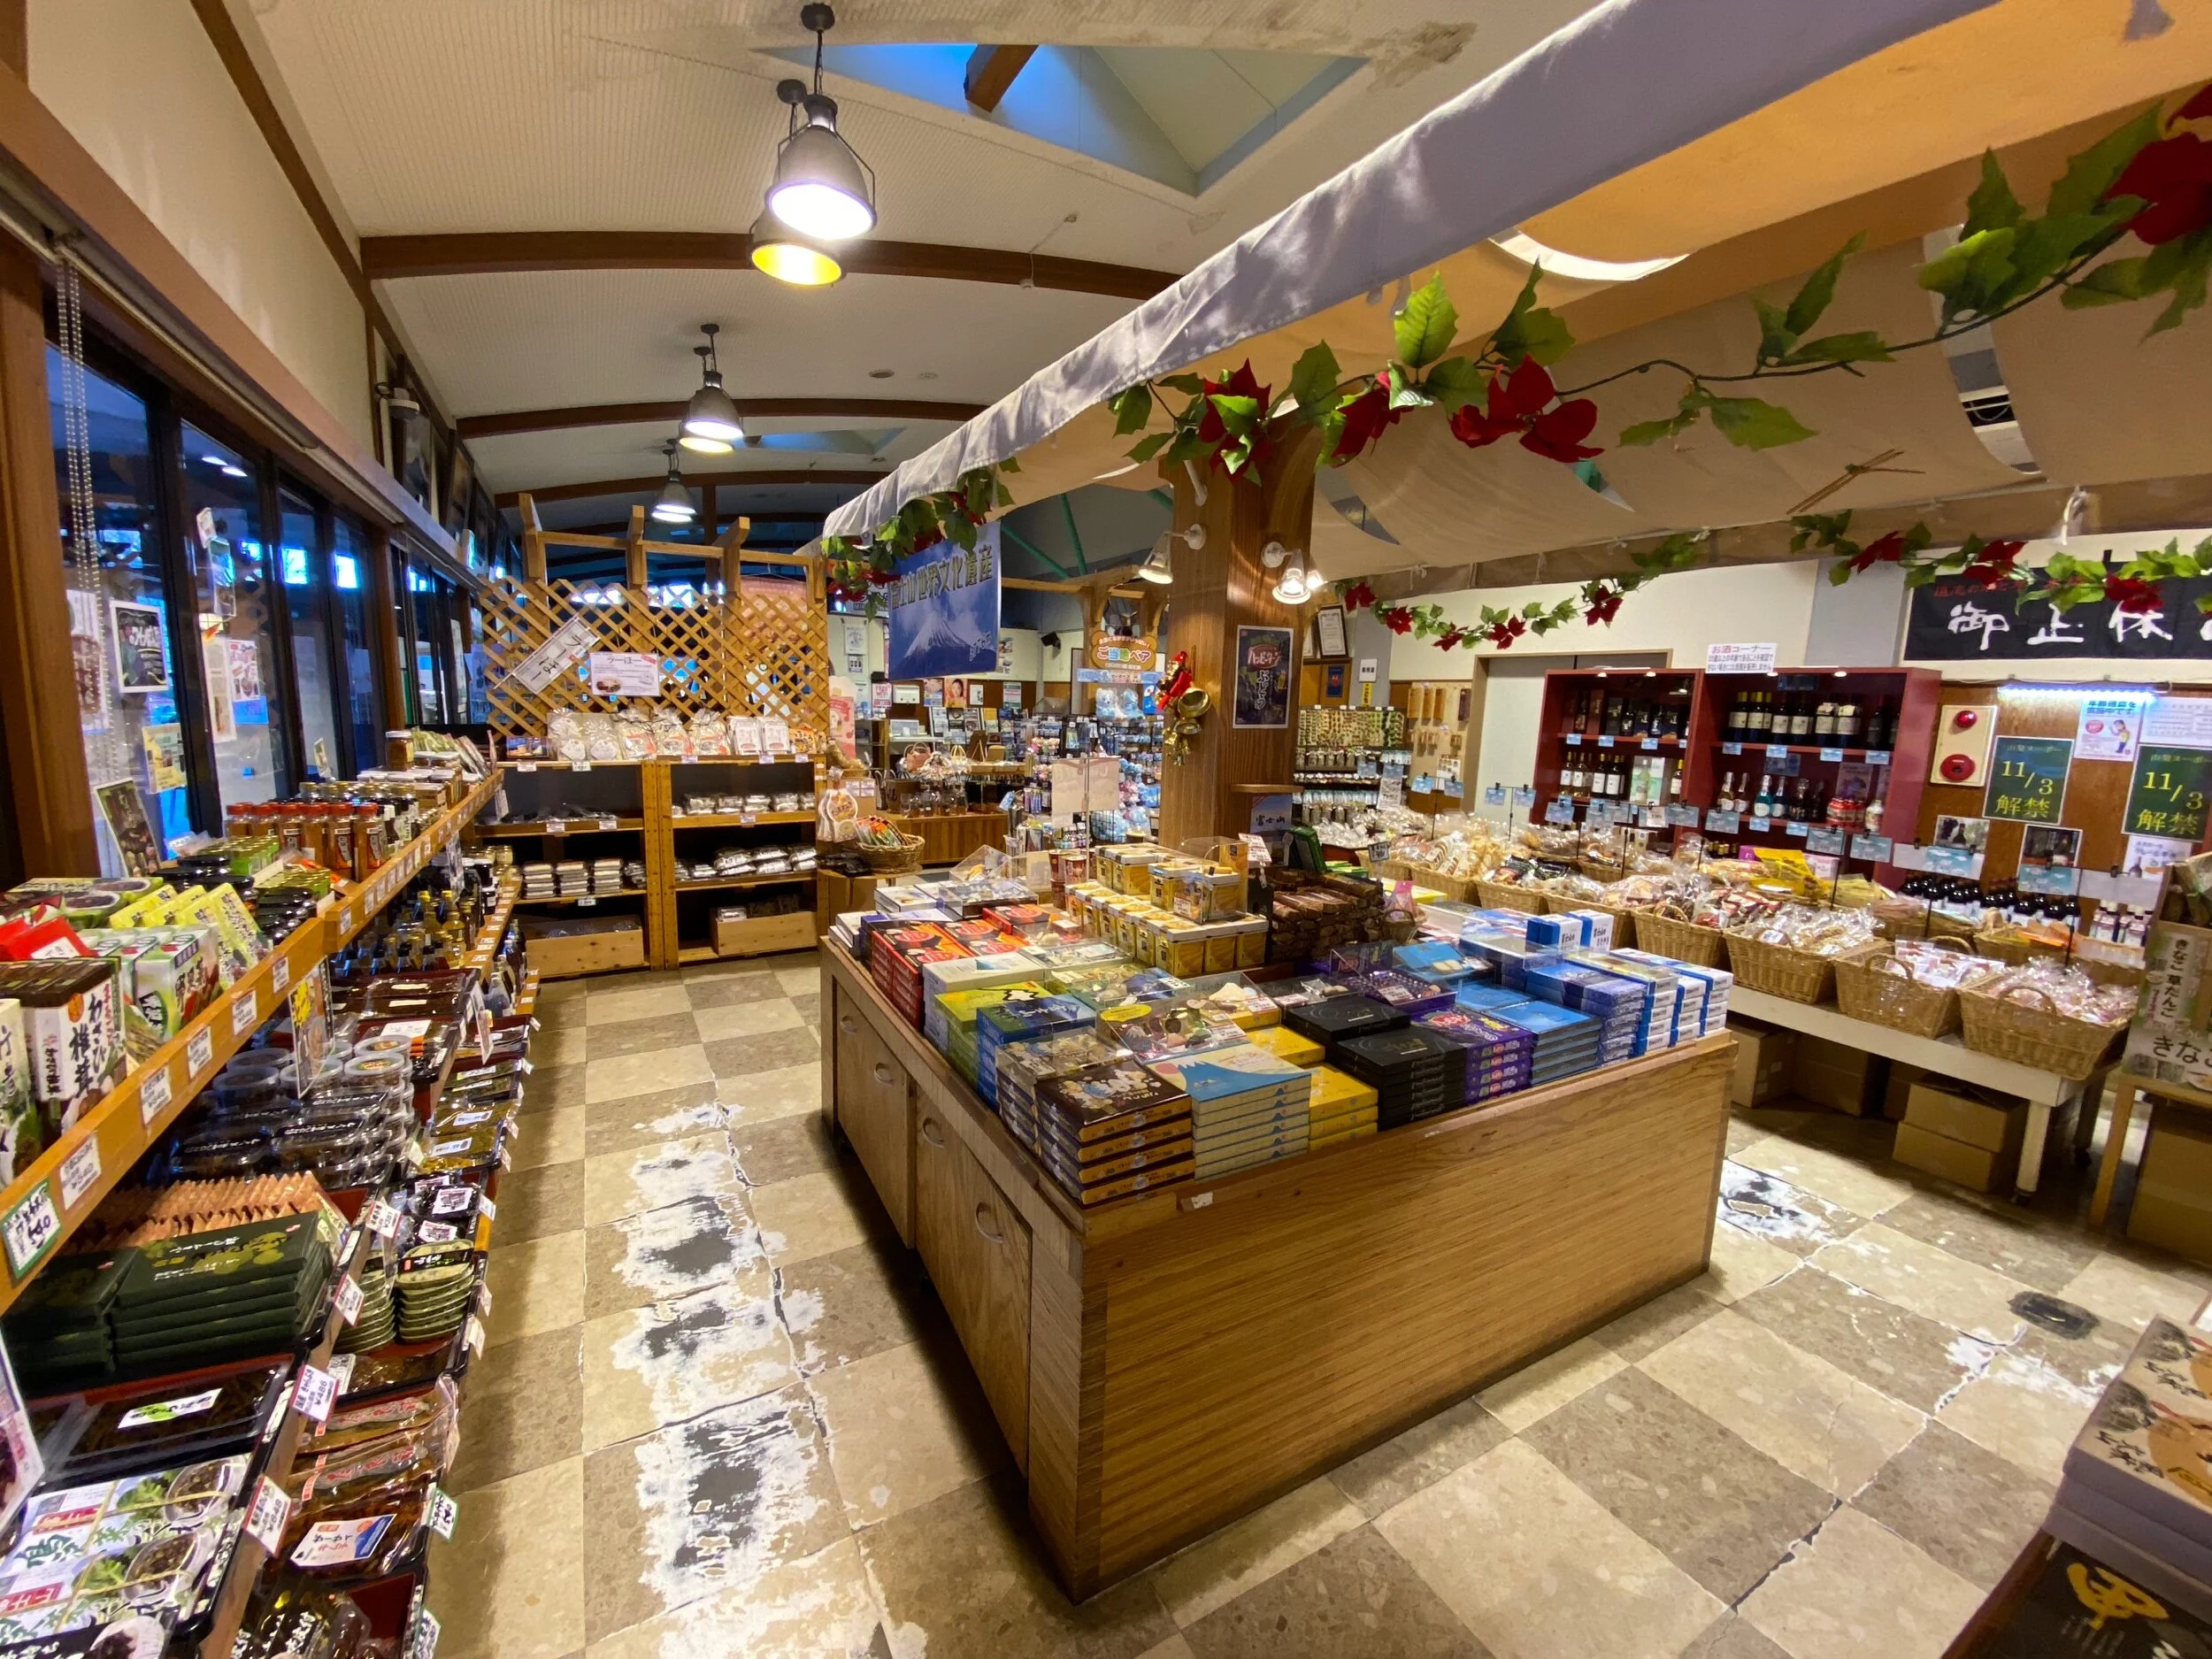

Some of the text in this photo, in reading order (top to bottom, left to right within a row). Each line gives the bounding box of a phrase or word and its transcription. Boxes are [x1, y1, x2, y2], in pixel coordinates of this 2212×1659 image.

[1711, 645, 1772, 654] お酒コーナー
[2001, 760, 2054, 795] 11/3
[2143, 772, 2203, 810] 11/3
[1994, 795, 2051, 818] 解禁
[2136, 809, 2199, 834] 解禁
